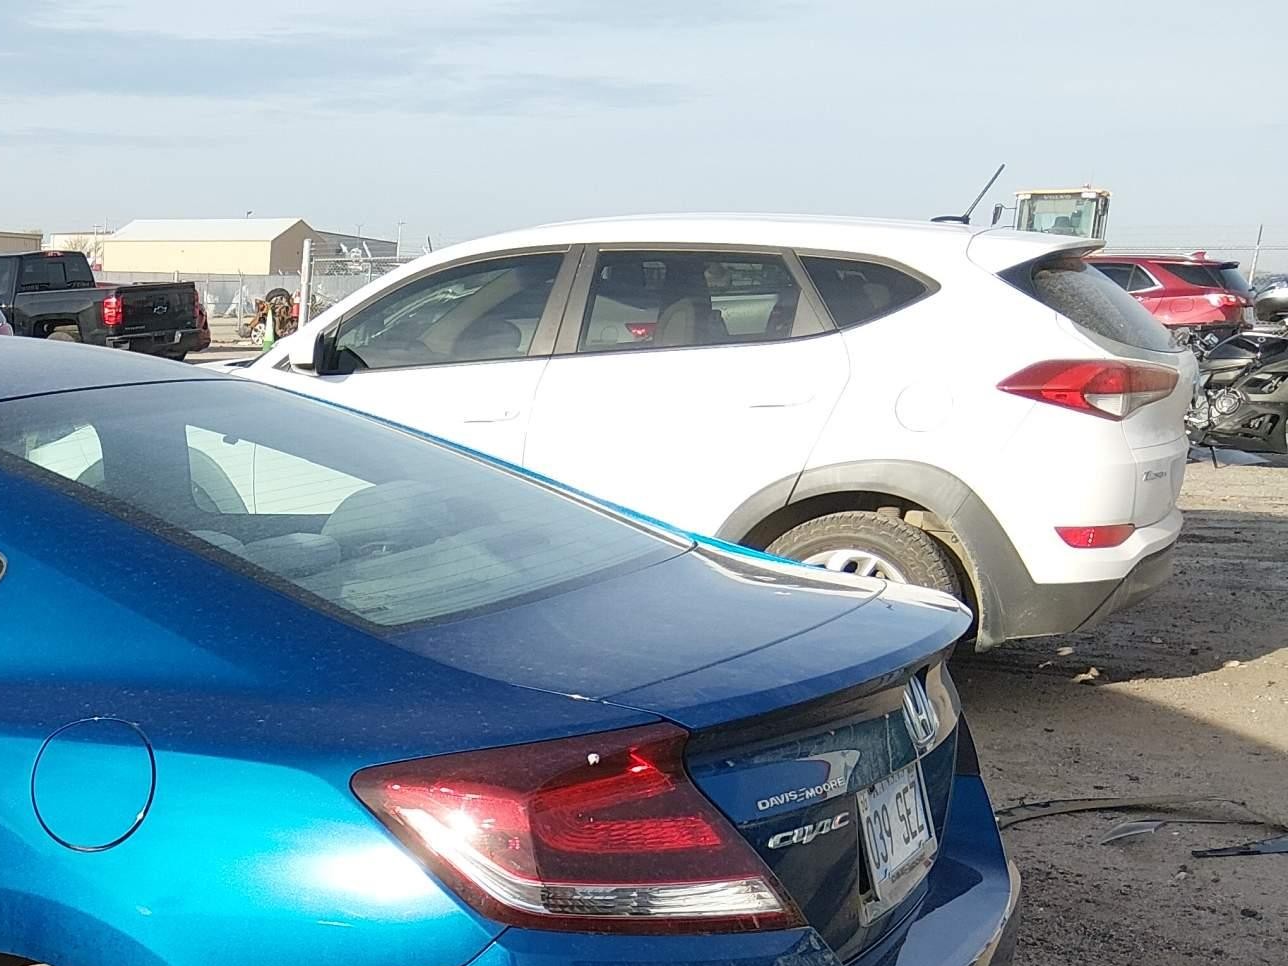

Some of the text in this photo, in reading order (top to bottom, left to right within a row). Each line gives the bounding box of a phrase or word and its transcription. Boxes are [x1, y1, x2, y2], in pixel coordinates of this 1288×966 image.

[768, 811, 850, 849] CIVIC
[866, 803, 894, 869] 039
[895, 781, 925, 845] SEZ
